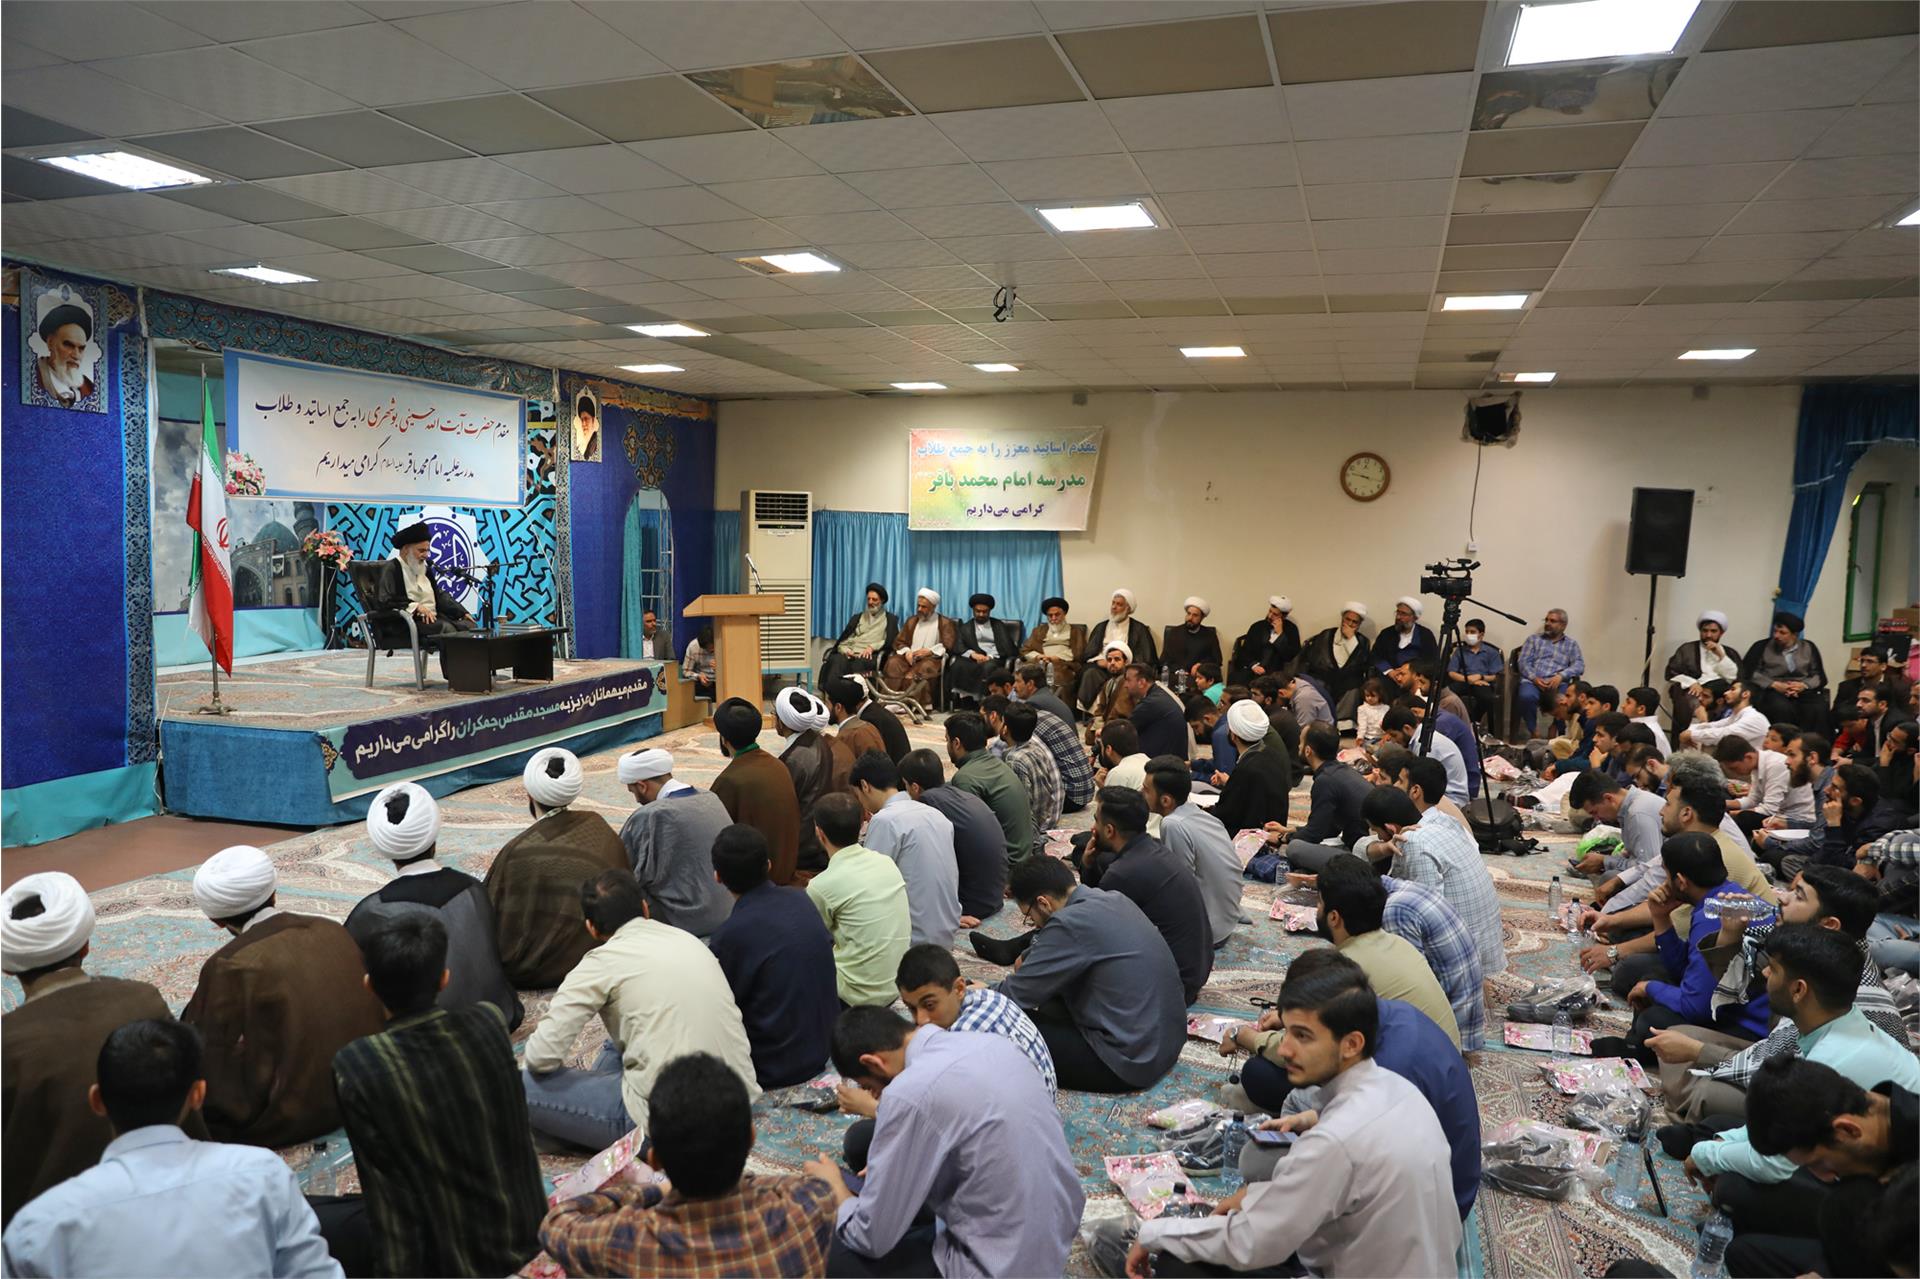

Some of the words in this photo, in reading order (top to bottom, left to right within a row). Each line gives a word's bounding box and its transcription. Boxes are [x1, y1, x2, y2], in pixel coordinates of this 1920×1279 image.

[255, 391, 294, 420] طلاب
[295, 402, 302, 414] و
[303, 399, 331, 425] اساتید
[333, 398, 350, 428] جمع
[399, 406, 436, 433] حسینی
[425, 417, 440, 431] الله
[440, 412, 467, 435] آیت
[464, 416, 494, 440] حضرت
[354, 434, 391, 477] گرامی
[917, 441, 945, 458] طلاب
[949, 445, 973, 458] جمع
[977, 444, 987, 457] به
[990, 441, 1000, 458] را
[1004, 443, 1030, 458] معزز
[1033, 441, 1066, 456] اساتید
[1069, 440, 1097, 456] مقدم
[404, 452, 417, 480] باقر
[416, 457, 429, 475] محمد
[428, 453, 443, 480] امام
[928, 468, 954, 492] باقر
[959, 474, 999, 487] محمد
[1002, 471, 1032, 491] امام
[1036, 473, 1086, 491] مدرسه
[589, 683, 628, 699] میهمانان
[626, 678, 648, 699] مقدم
[532, 703, 560, 720] مسجد
[559, 700, 571, 714] به
[569, 693, 591, 712] عزیز
[455, 714, 499, 738] جمکران
[498, 706, 534, 729] مقدس
[410, 719, 448, 750] گرامی
[446, 720, 456, 740] را
